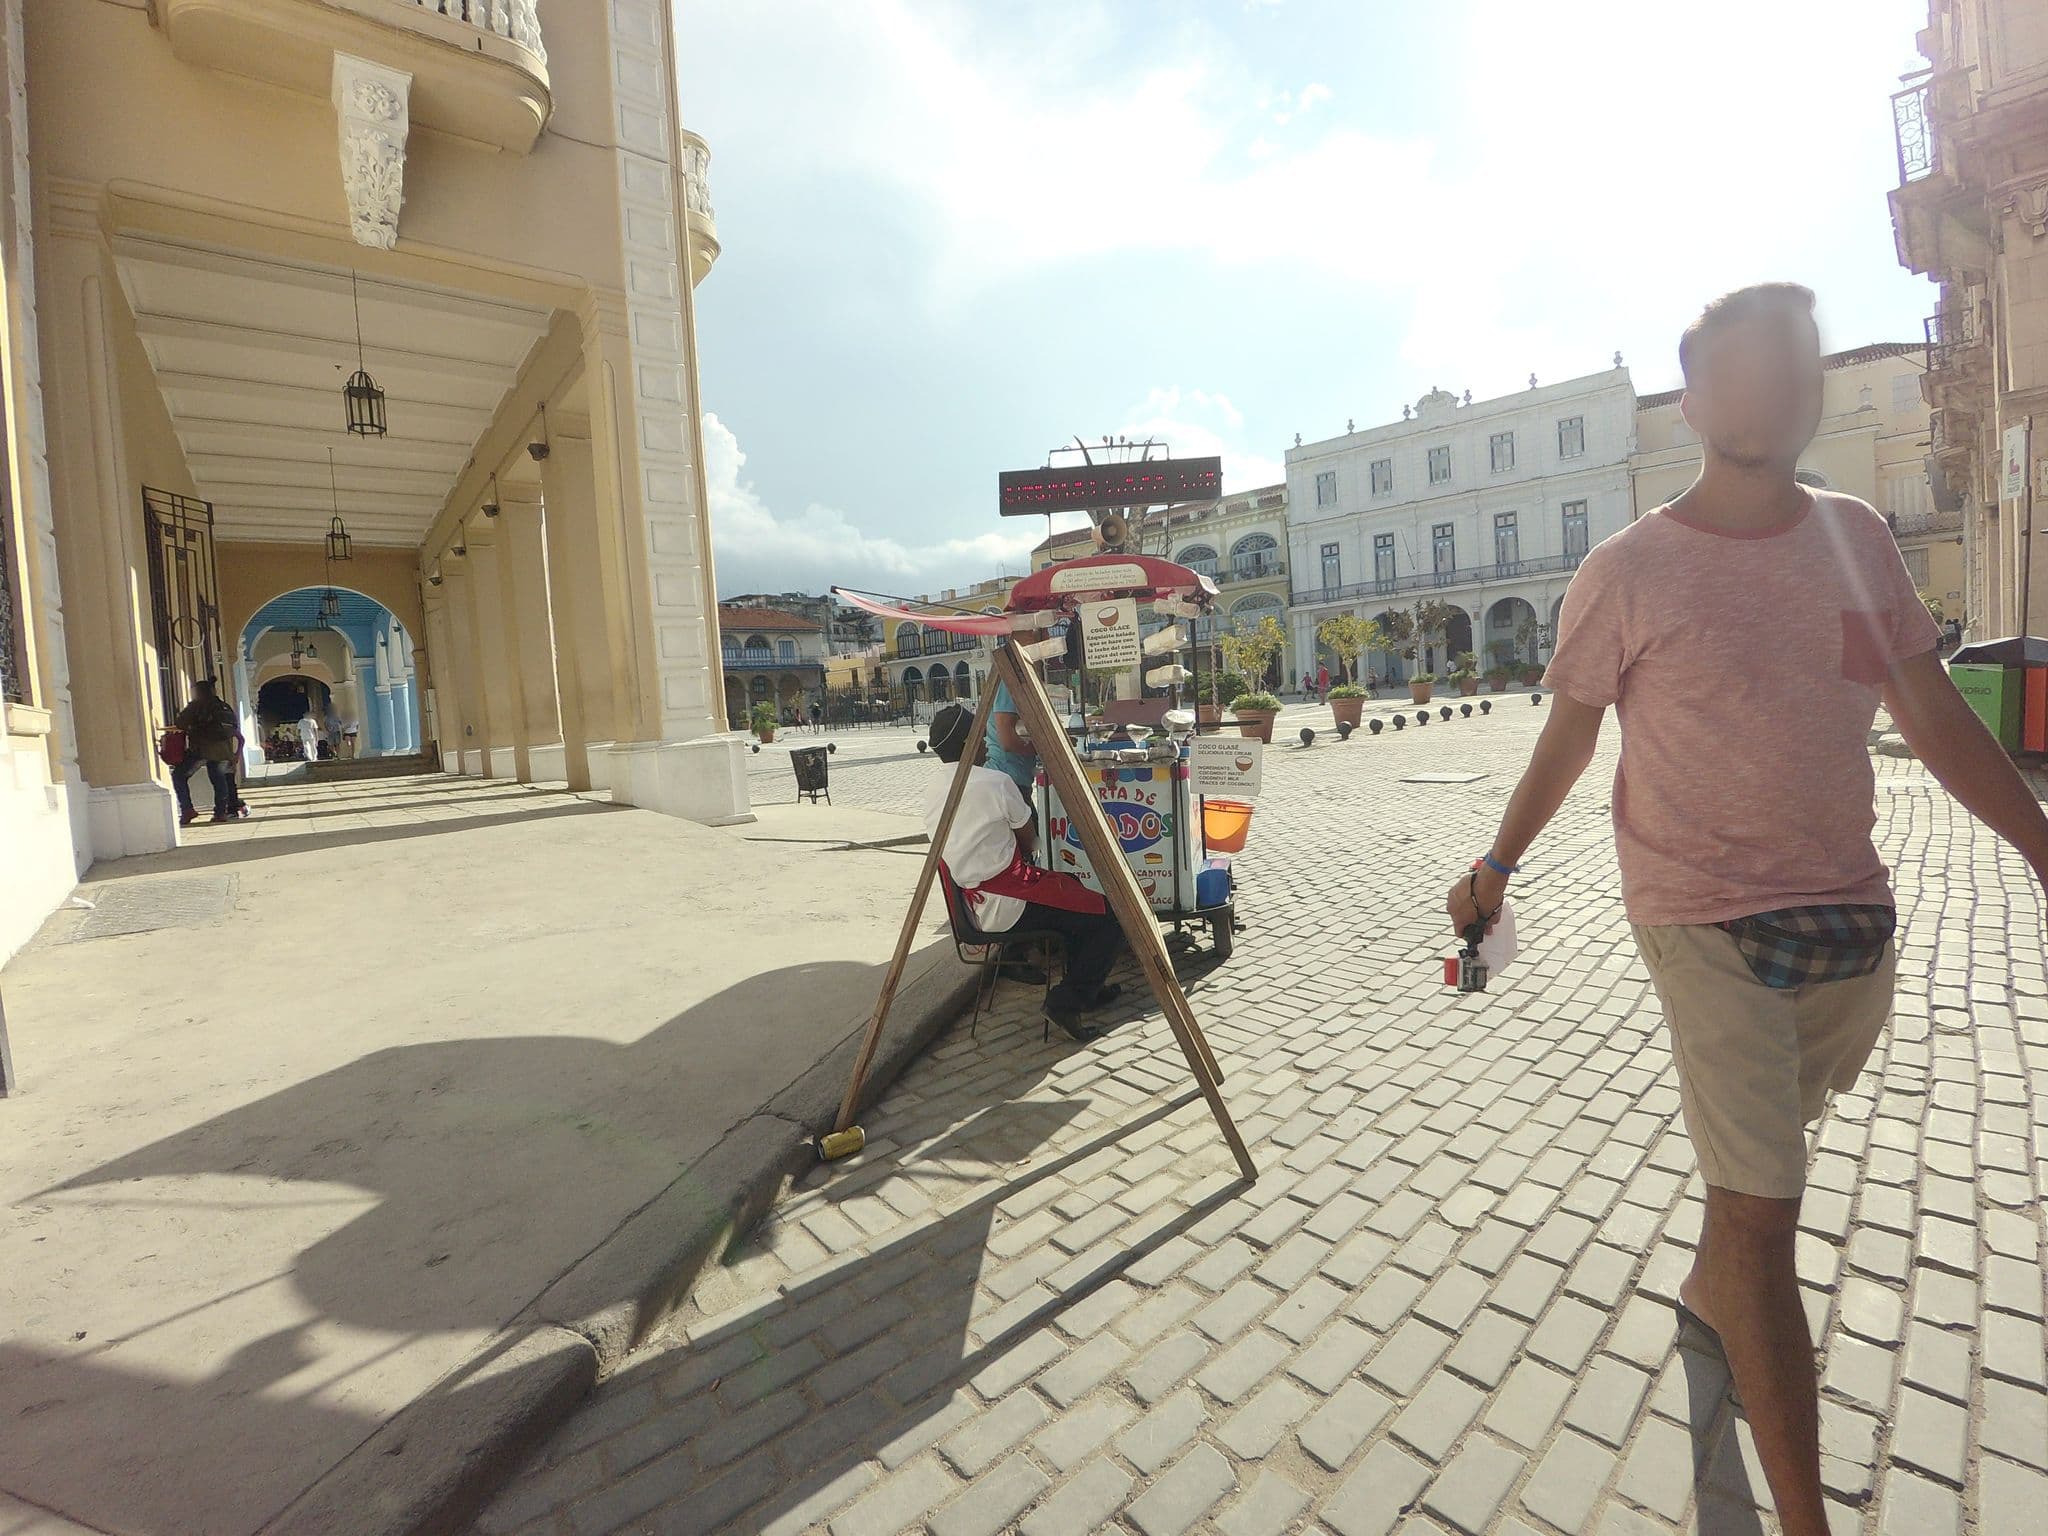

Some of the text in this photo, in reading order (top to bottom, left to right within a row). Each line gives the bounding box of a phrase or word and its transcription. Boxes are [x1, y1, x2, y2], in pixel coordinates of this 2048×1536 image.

[1098, 785, 1157, 806] RTA DE
[1050, 811, 1174, 841] HDOS
[1136, 869, 1173, 878] CADITOS
